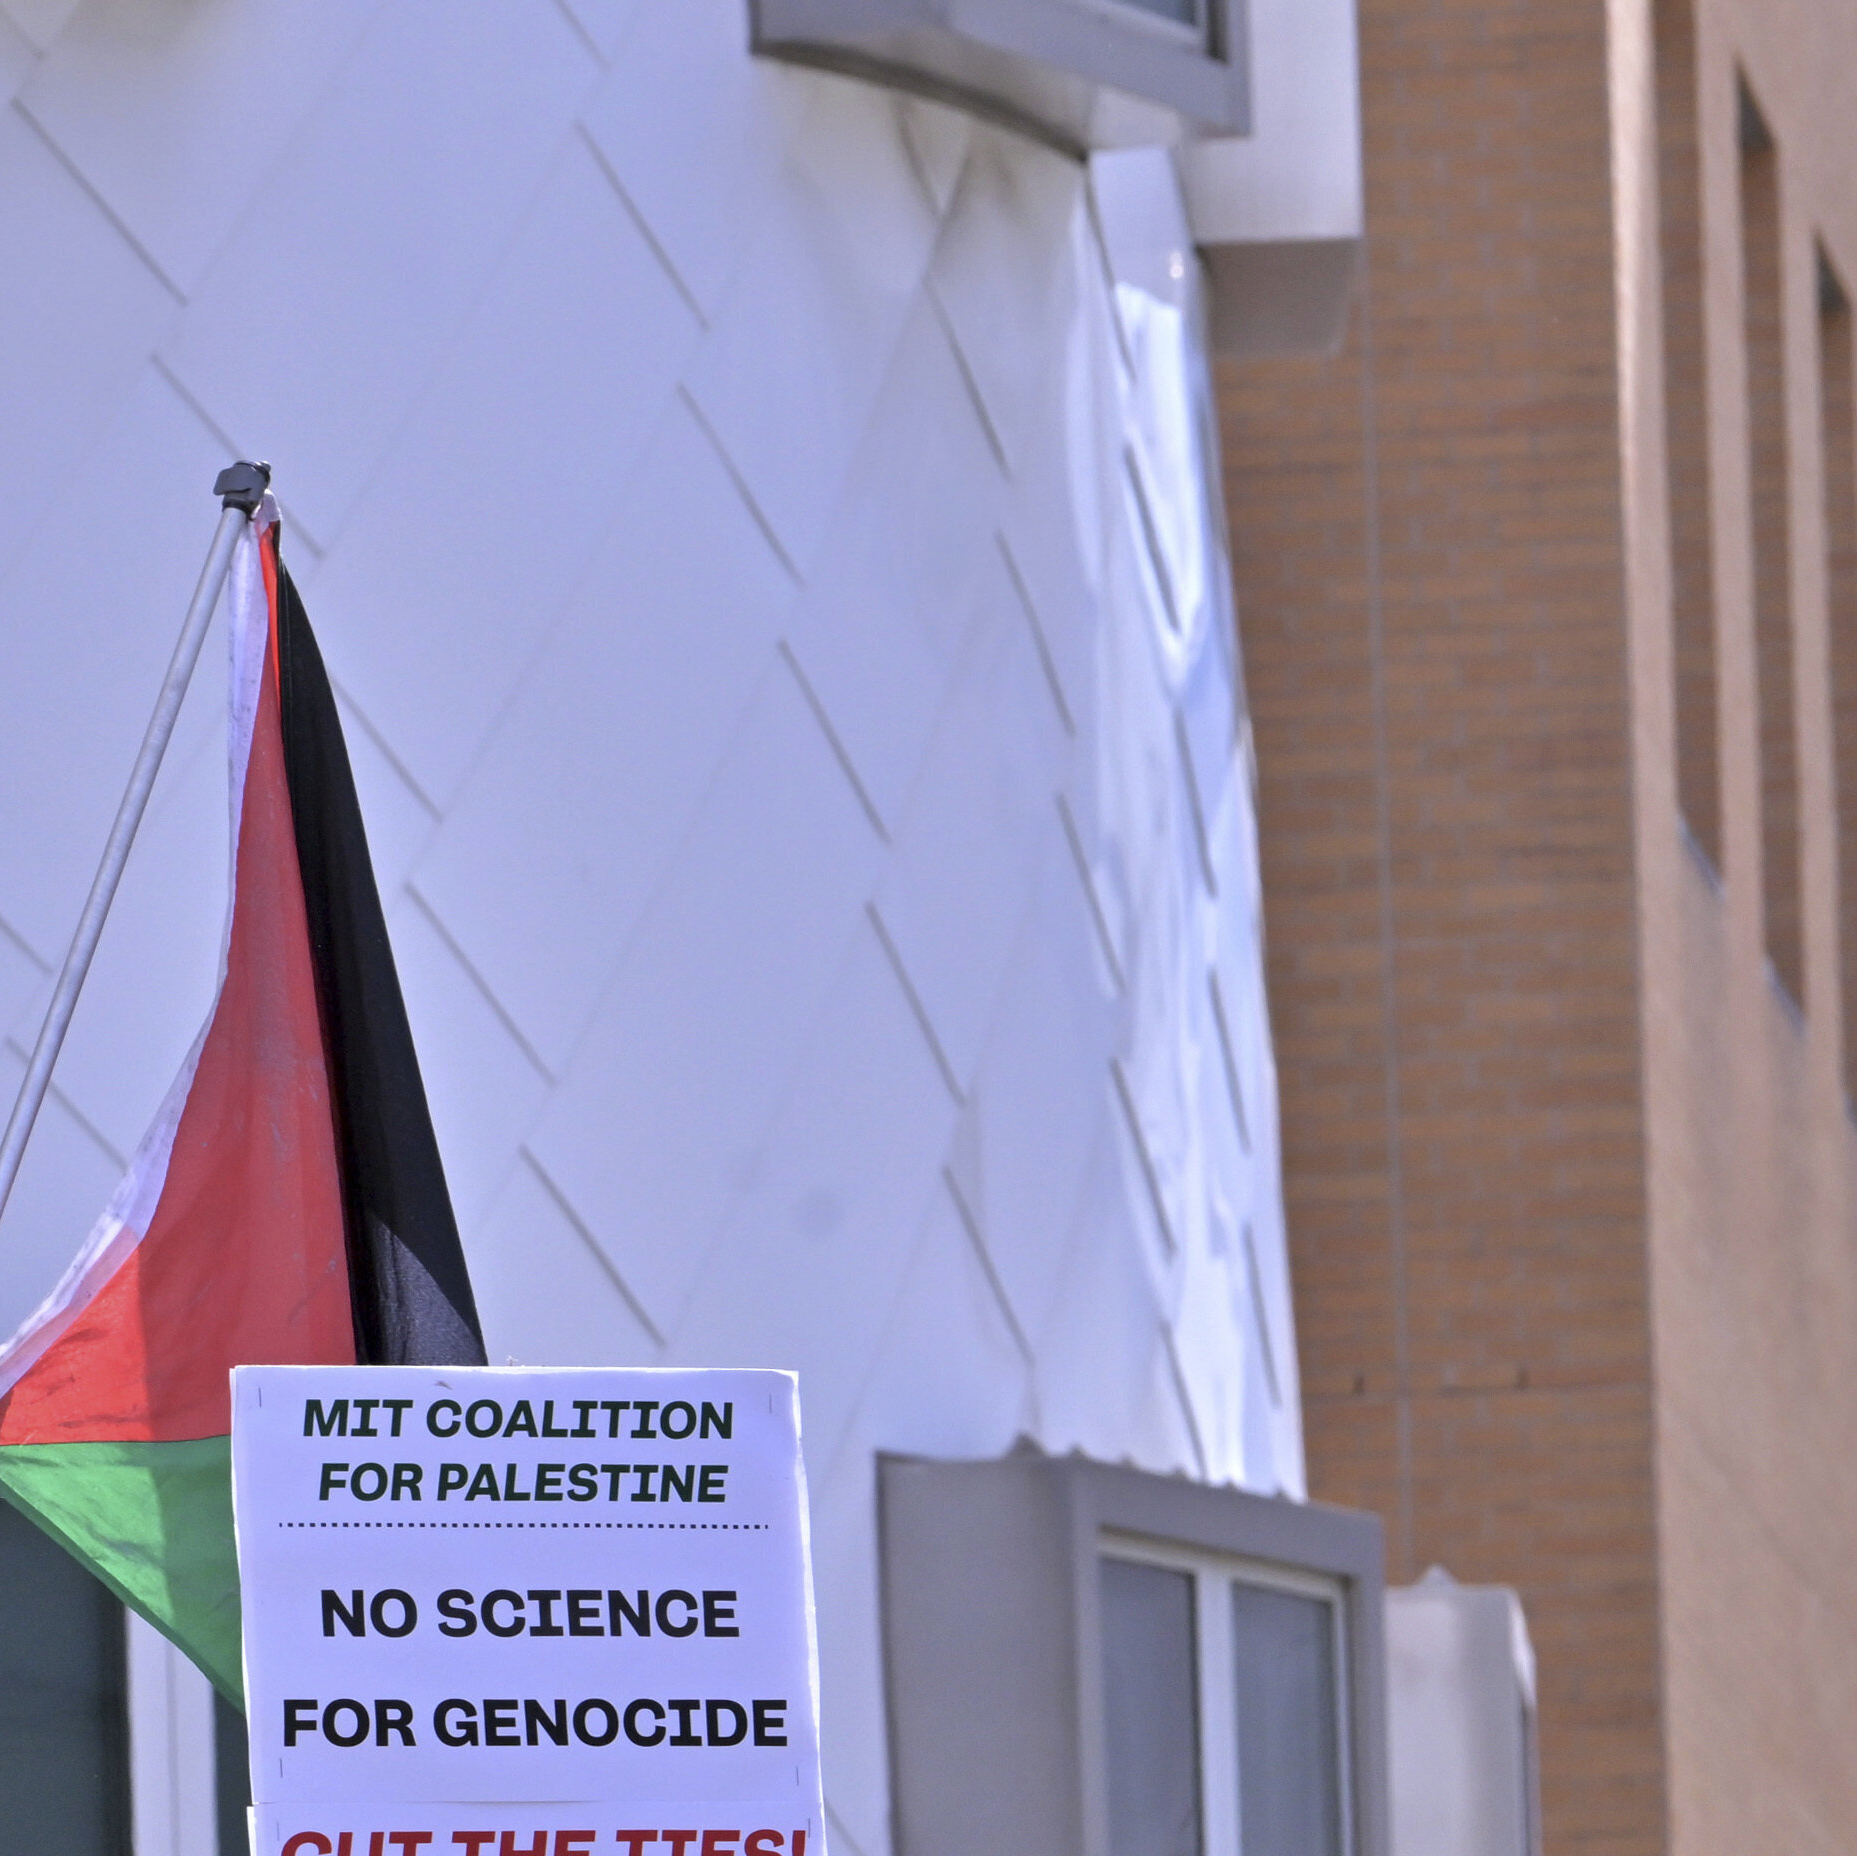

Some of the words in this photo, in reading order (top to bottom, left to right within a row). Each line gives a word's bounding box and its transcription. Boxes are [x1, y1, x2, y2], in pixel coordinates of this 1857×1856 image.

[303, 1399, 414, 1438] MIT
[426, 1398, 733, 1440] COALITION
[318, 1462, 423, 1502] FOR
[436, 1462, 729, 1503] PALESTINE
[320, 1588, 418, 1638] NO
[436, 1588, 740, 1638] SCIENCE
[283, 1698, 417, 1748] FOR
[433, 1698, 788, 1748] GENOCIDE
